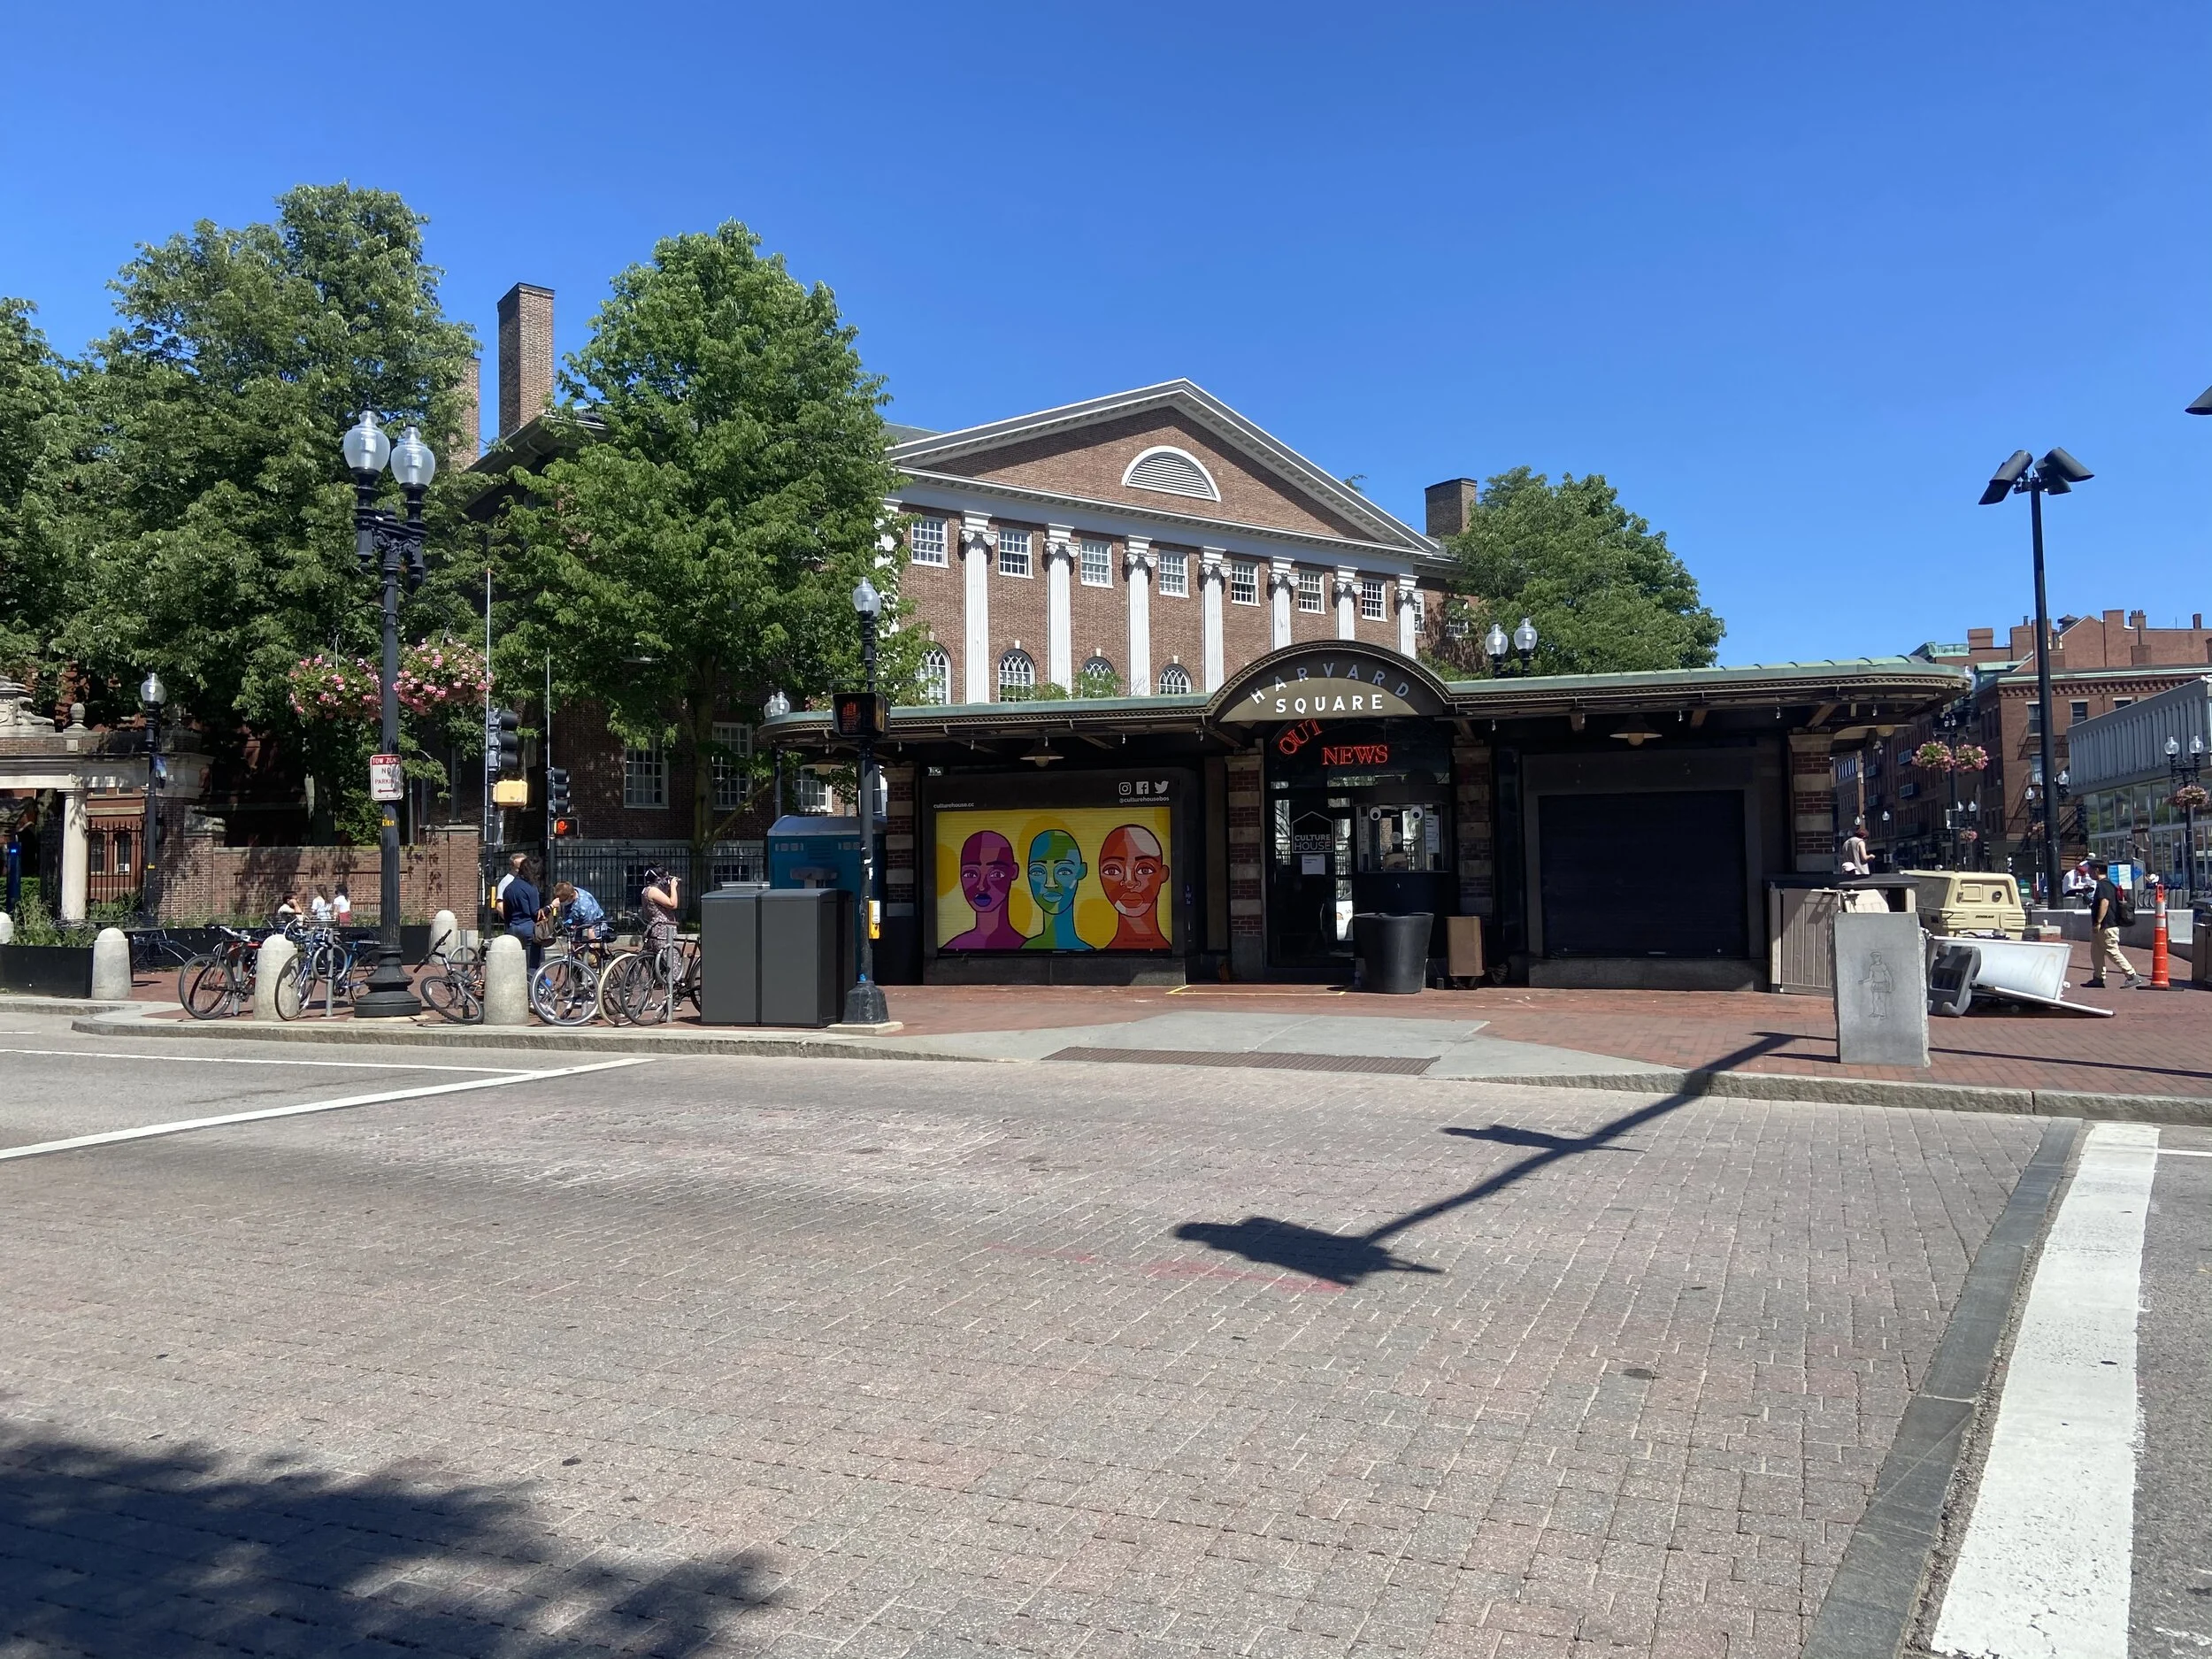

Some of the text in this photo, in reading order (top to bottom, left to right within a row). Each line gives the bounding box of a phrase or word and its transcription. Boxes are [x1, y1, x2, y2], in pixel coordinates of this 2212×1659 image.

[1249, 663, 1409, 704] HARVARD
[1275, 694, 1383, 713] SQUARE
[1279, 718, 1324, 755] OUT
[1322, 743, 1388, 765] NEWS
[1294, 841, 1331, 851] HOUSE
